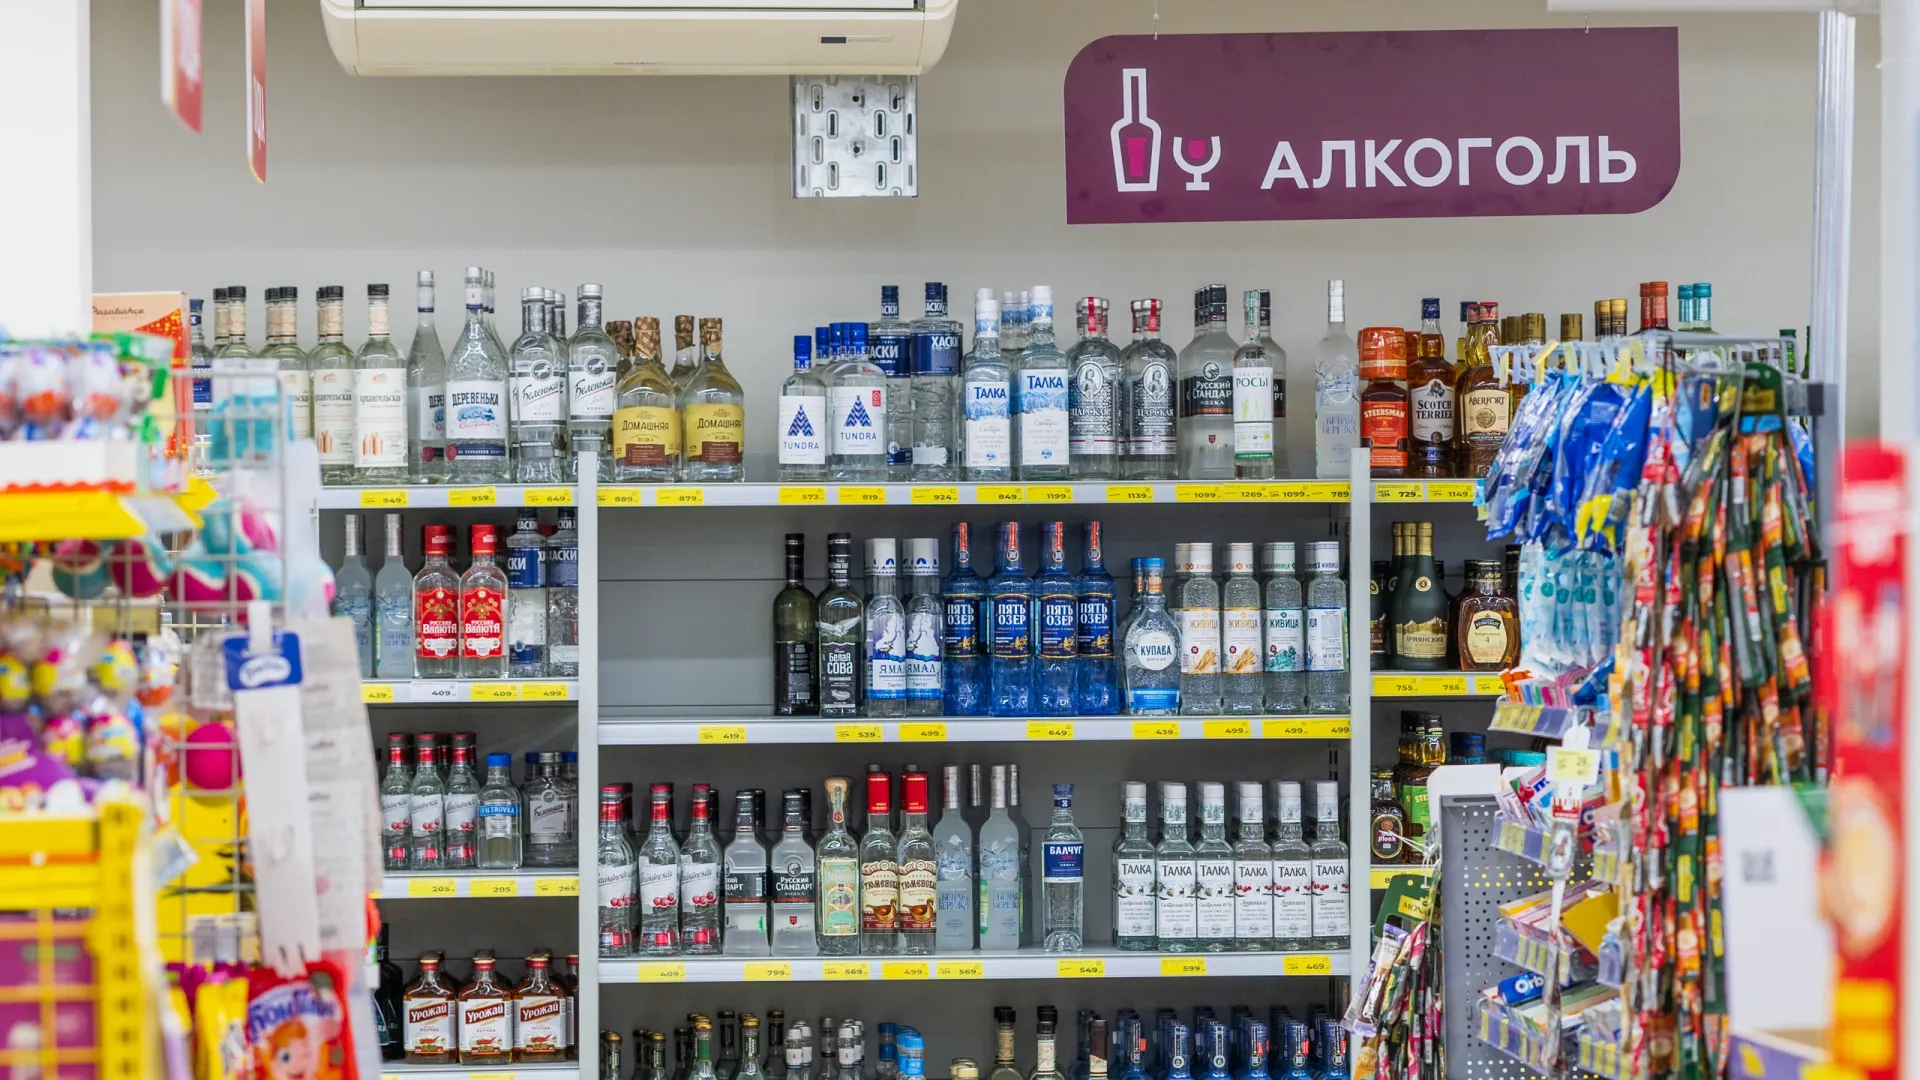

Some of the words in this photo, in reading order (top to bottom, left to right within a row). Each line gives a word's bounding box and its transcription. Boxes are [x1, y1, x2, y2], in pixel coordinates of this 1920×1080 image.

[1261, 135, 1638, 190] АЛКОГОЛЬ
[1027, 375, 1064, 390] ТАЛКА
[1236, 377, 1268, 388] РОСЫ
[974, 386, 1006, 399] ТАЛКА
[452, 391, 499, 406] ДЕРЕВЕНЬКА
[1468, 396, 1507, 406] ABERFORT
[1418, 400, 1452, 410] SCOTCH
[1364, 410, 1405, 418] STEERSMAN
[1416, 410, 1453, 420] TERRIER
[840, 432, 876, 440] TUNDRA
[784, 441, 819, 450] TUNDRA
[947, 604, 974, 614] ПЯТЬ
[998, 604, 1026, 614] ПЯТЬ
[1046, 604, 1073, 615] ПЯТЬ
[1080, 603, 1107, 613] ПЯТЬ
[947, 614, 975, 625] ОЗЕР
[998, 614, 1026, 625] ОЗЕР
[1046, 615, 1073, 626] ОЗЕР
[1080, 613, 1107, 624] ОЗЕР
[1228, 619, 1258, 629] ЖИВИЦА
[1269, 619, 1299, 630] ЖИВИЦА
[1140, 644, 1172, 656] КУПАВА
[906, 663, 936, 673] ЯМАЛ
[481, 806, 515, 815] FILTROVKA
[1050, 845, 1082, 856] БАЛЧУГ
[1121, 863, 1151, 876] ТАЛКА
[1162, 865, 1192, 877] ТАЛКА
[1200, 865, 1230, 877] ТАЛКА
[1239, 866, 1268, 877] ТАЛКА
[1278, 866, 1307, 877] ТАЛКА
[1316, 864, 1344, 877] ТАЛКА
[411, 1003, 447, 1022] Урожай
[467, 1004, 503, 1023] Урожай
[522, 1003, 559, 1020] Урожай
